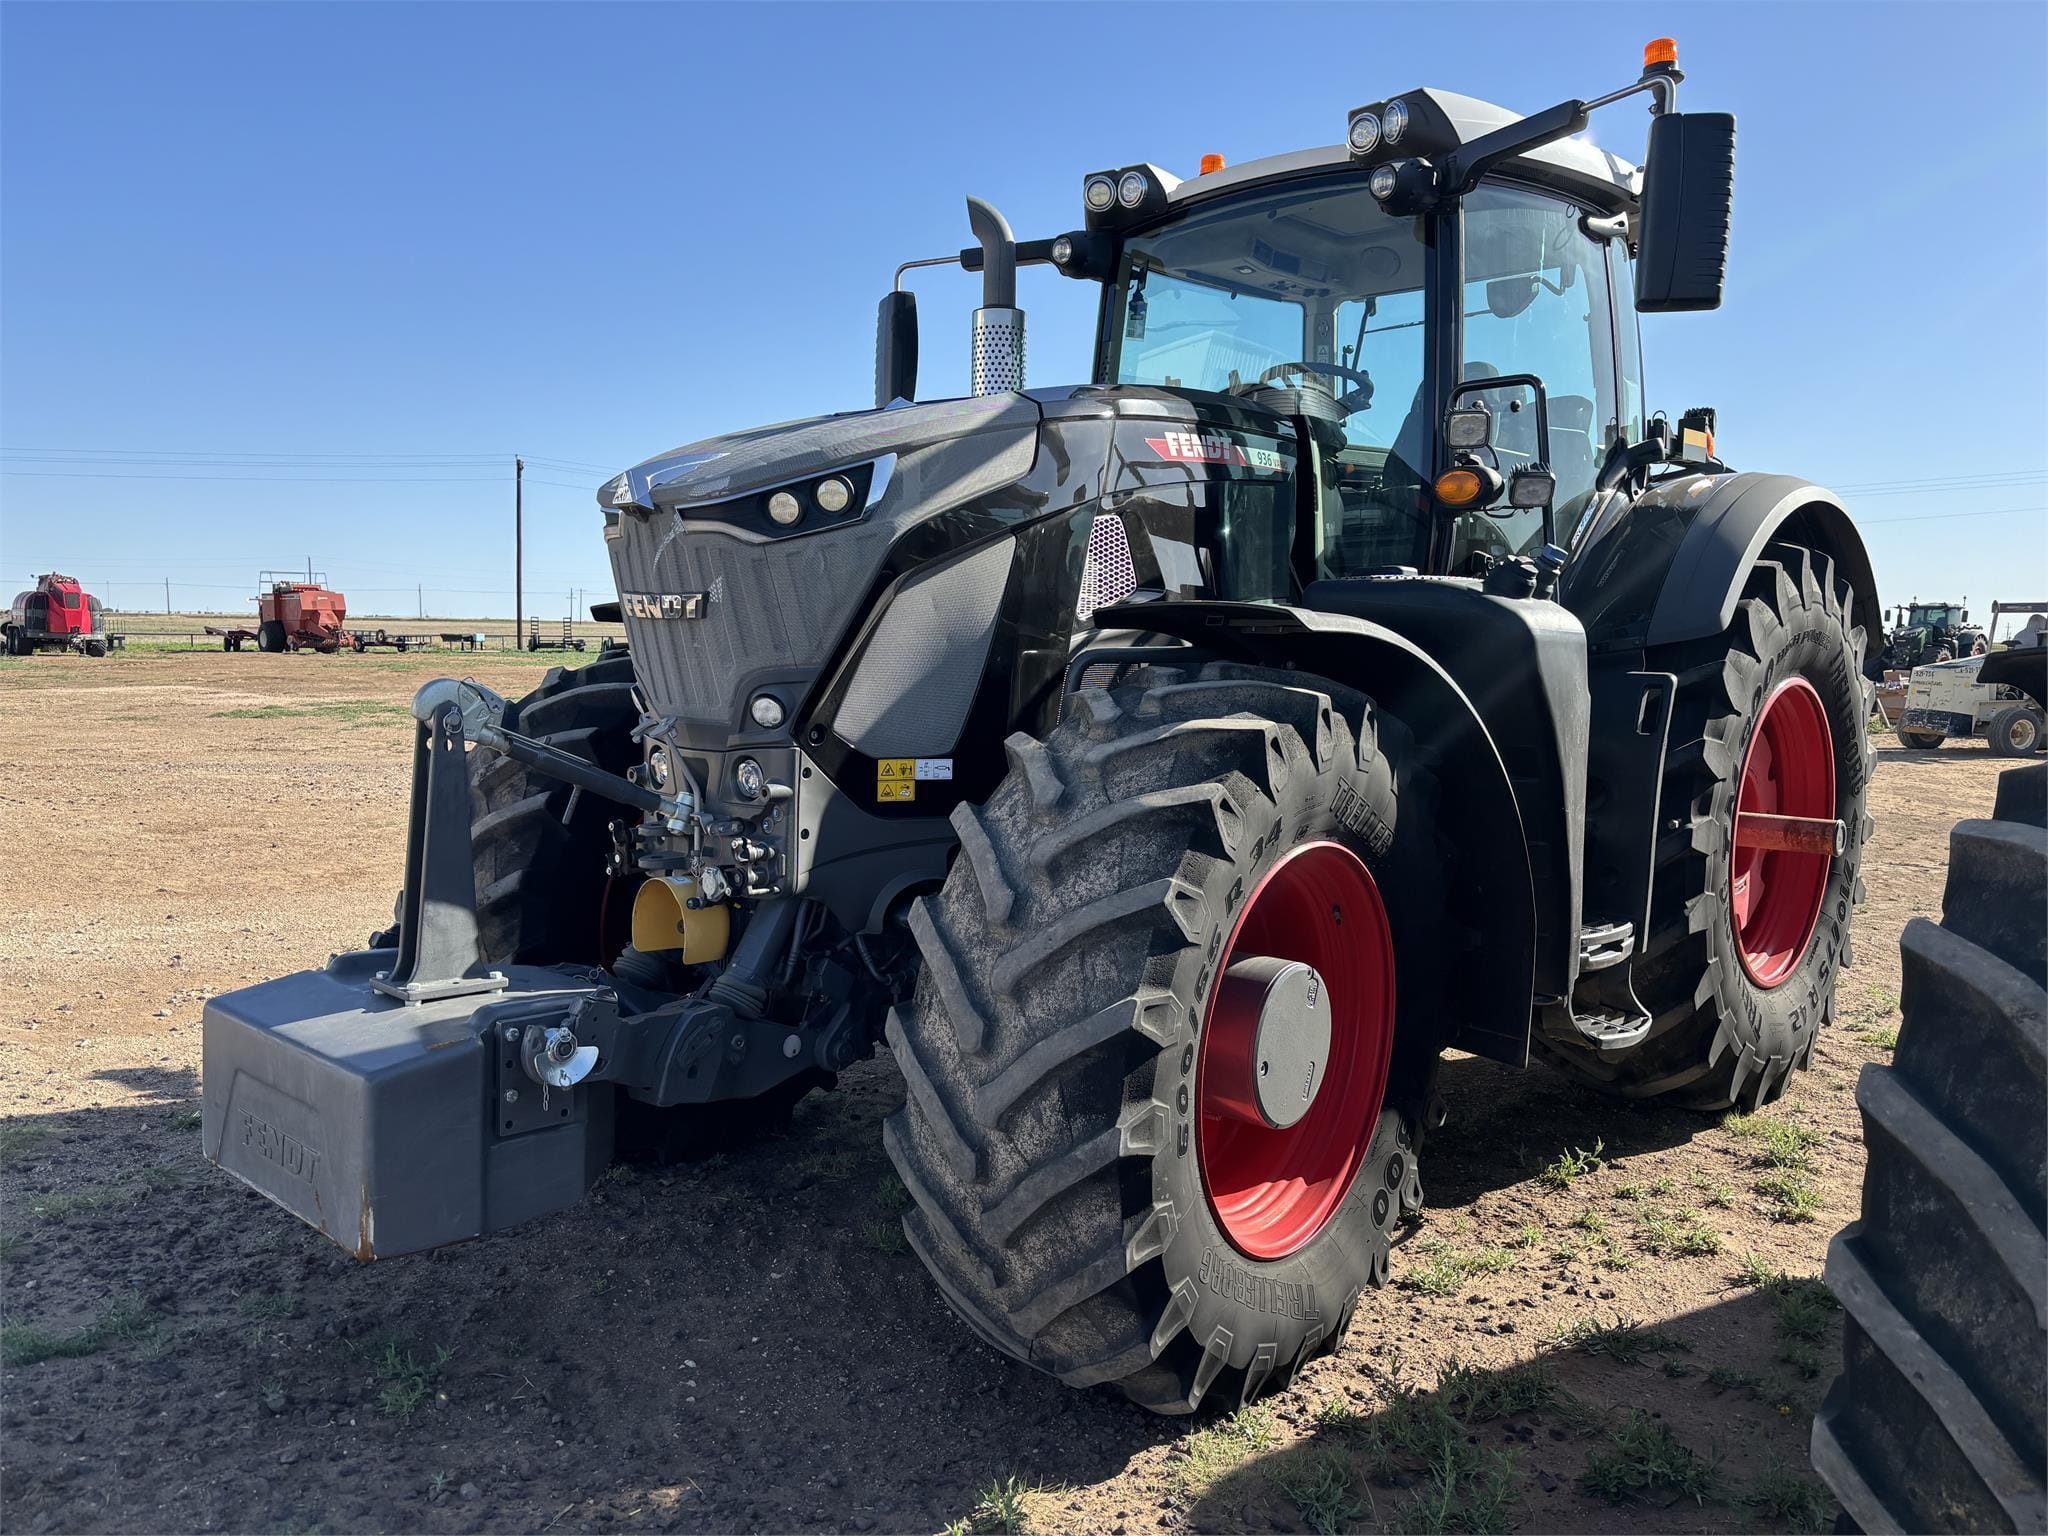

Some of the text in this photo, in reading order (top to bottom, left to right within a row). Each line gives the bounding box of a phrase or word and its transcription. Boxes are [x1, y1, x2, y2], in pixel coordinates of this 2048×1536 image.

[1164, 431, 1233, 460] FENDT
[1257, 451, 1272, 467] 936
[621, 593, 703, 619] FENDT
[238, 1106, 321, 1184] FENDT
[1198, 1246, 1321, 1321] TRELLEBORG
